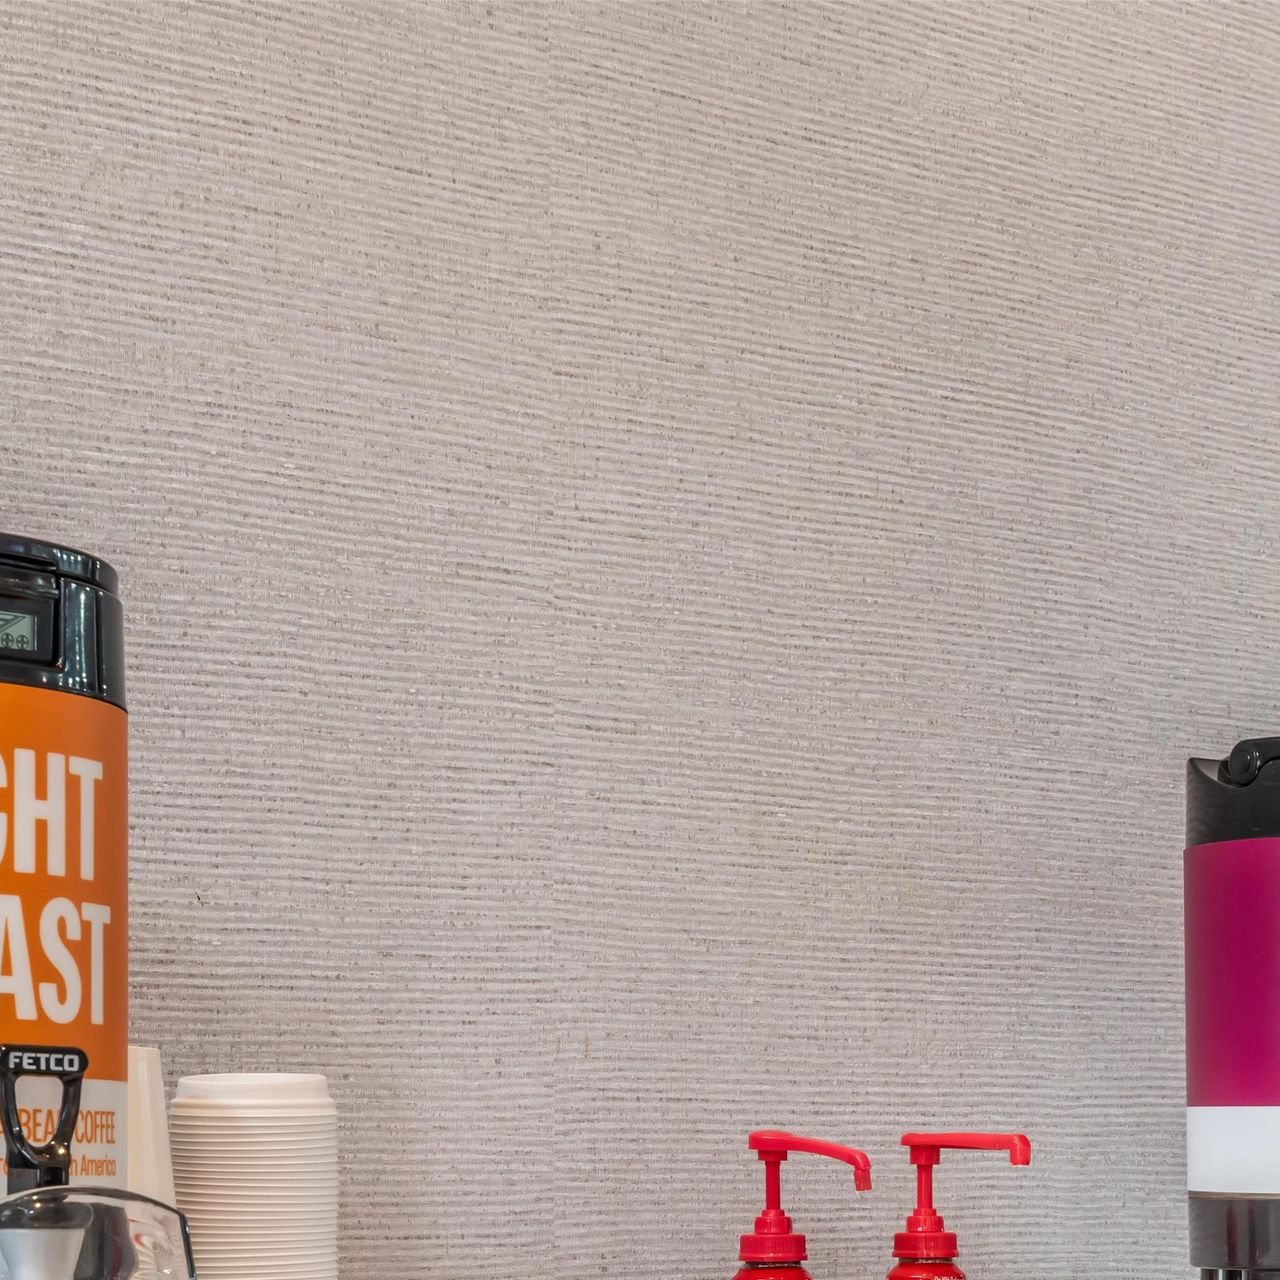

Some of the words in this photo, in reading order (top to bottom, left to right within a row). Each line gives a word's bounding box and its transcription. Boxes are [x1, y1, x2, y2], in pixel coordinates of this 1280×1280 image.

[9, 1052, 80, 1072] FETCO
[18, 1108, 61, 1143] BEA
[74, 1110, 116, 1144] COFFEE
[80, 1154, 116, 1177] America
